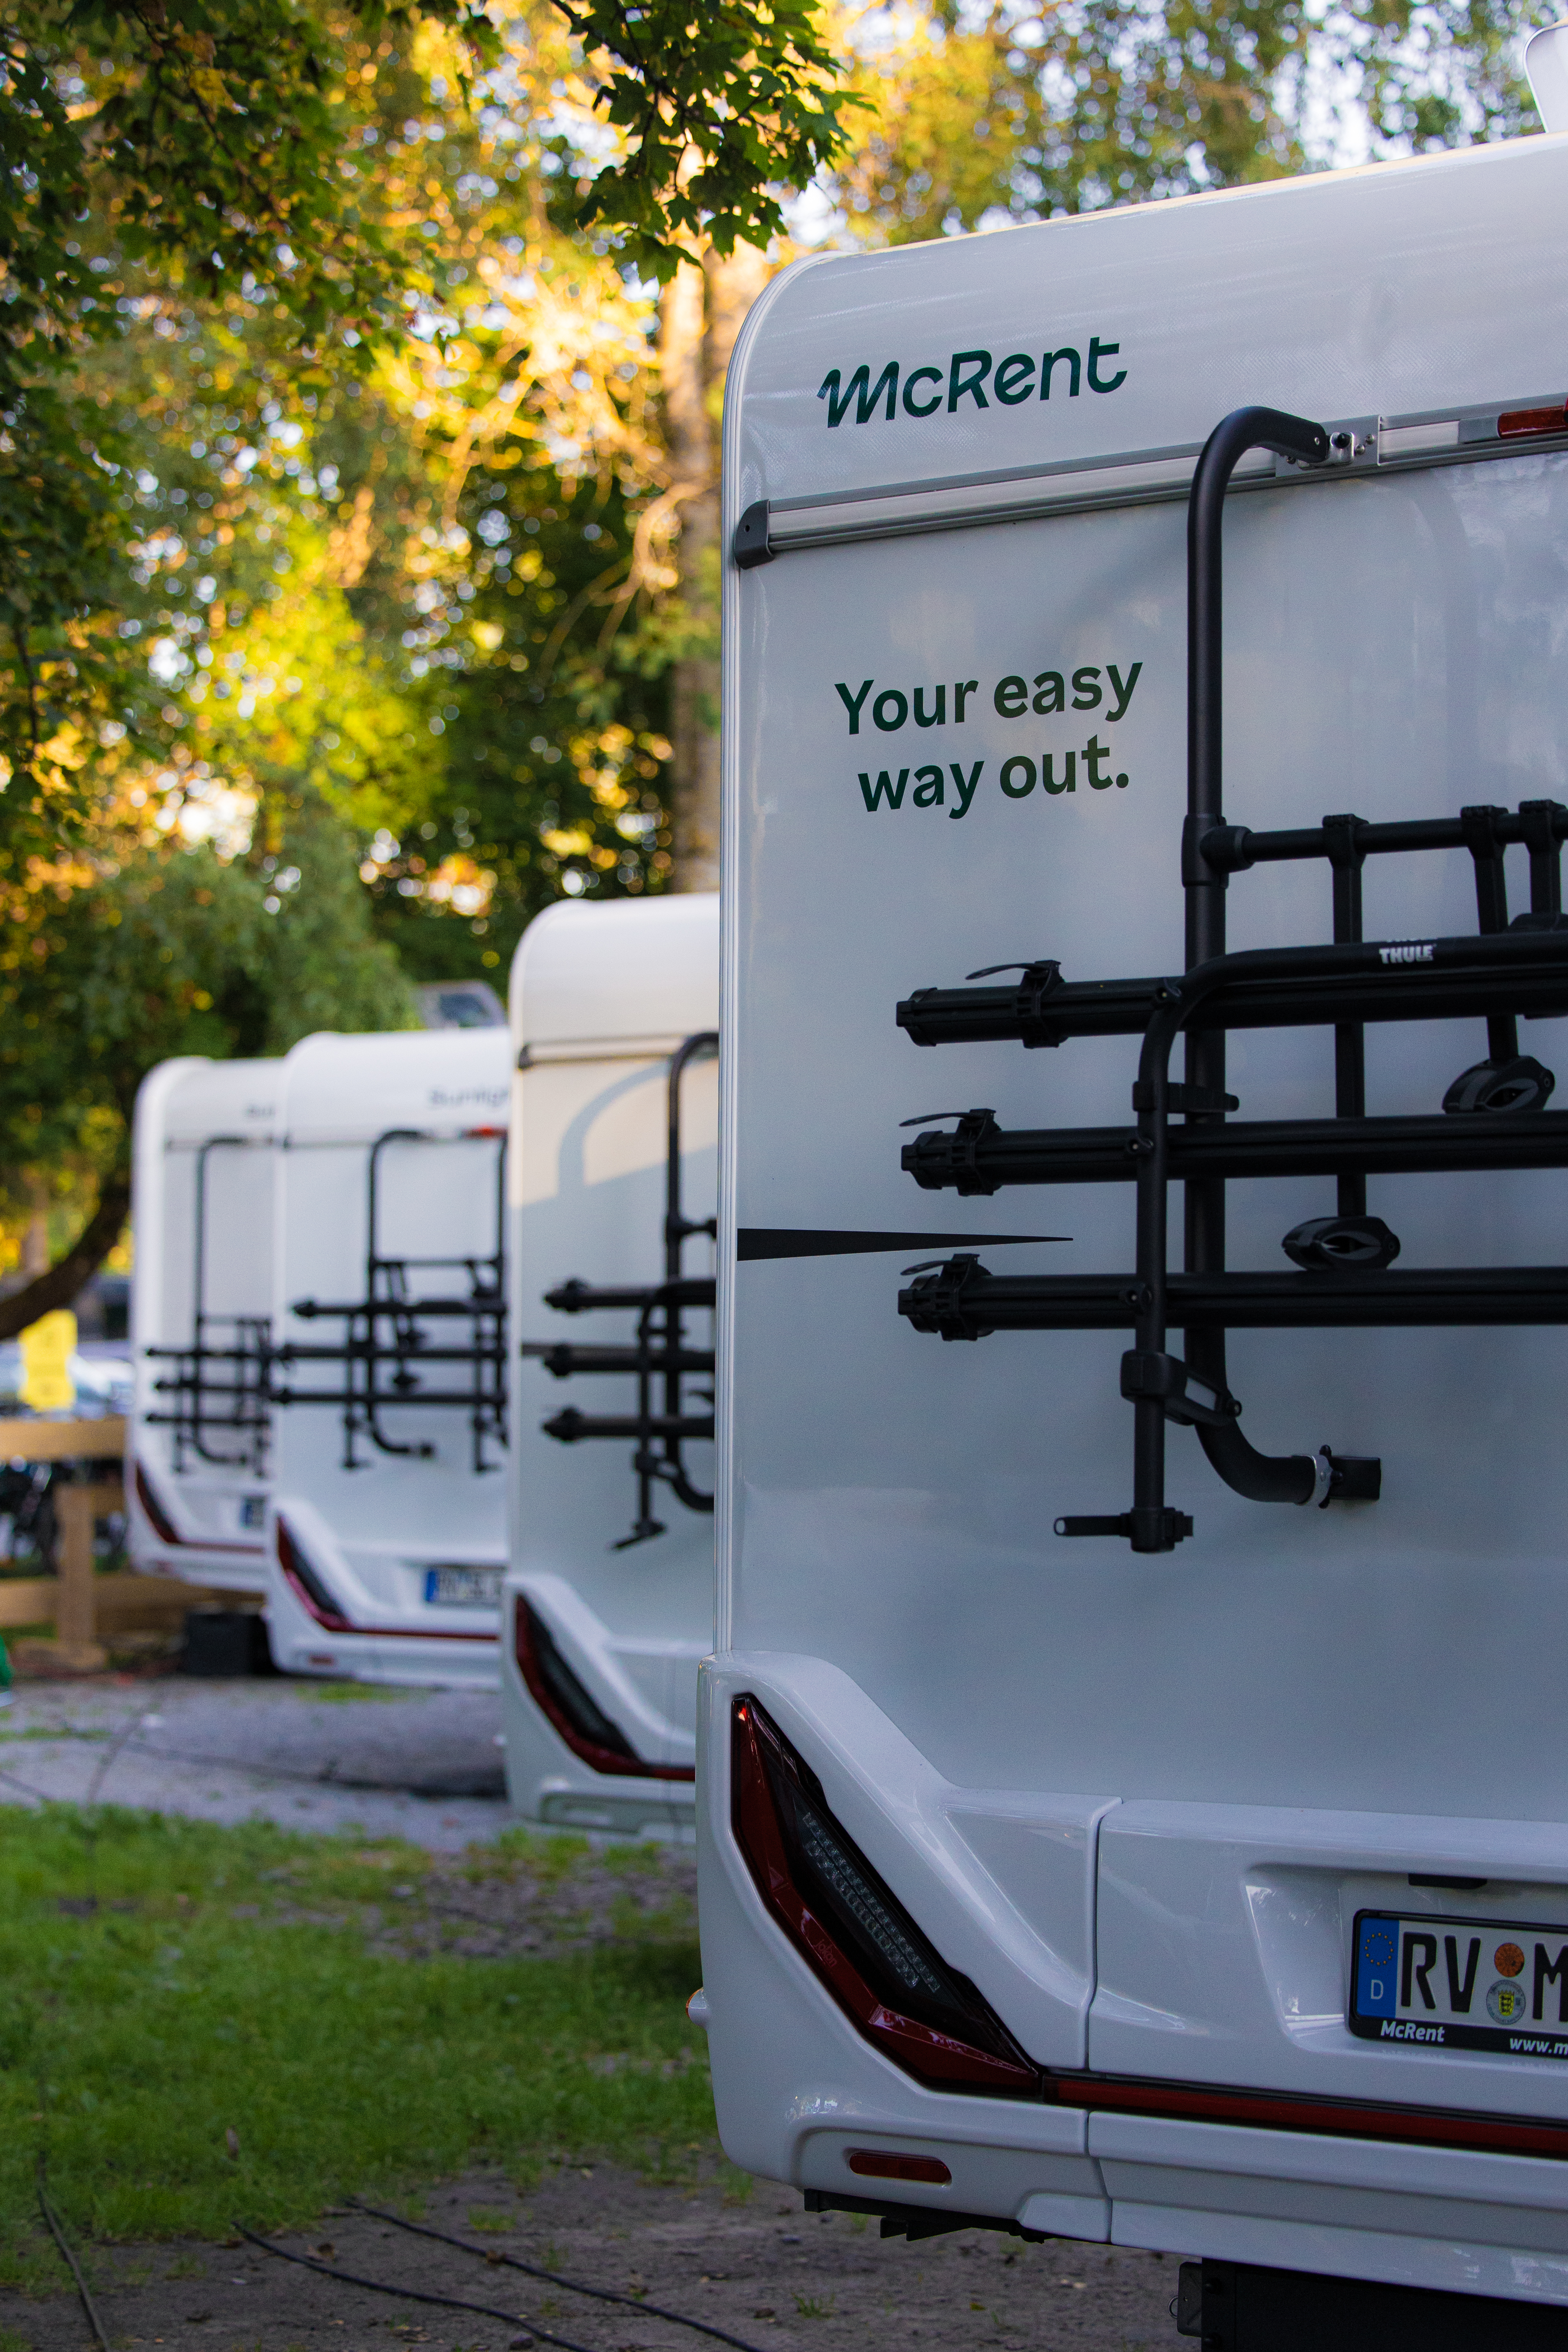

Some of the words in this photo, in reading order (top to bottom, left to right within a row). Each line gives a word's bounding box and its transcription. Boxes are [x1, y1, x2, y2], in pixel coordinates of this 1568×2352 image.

[817, 336, 1128, 428] McRent
[834, 679, 979, 735] Your
[993, 662, 1143, 722] easy
[858, 760, 985, 819] way
[1000, 734, 1129, 799] out.
[1379, 944, 1433, 964] THULE
[813, 1939, 837, 1967] jokon
[1401, 1931, 1481, 2014] RV
[1370, 1979, 1384, 2000] D
[1380, 2020, 1445, 2042] McRent
[1509, 2038, 1568, 2055] www.m
